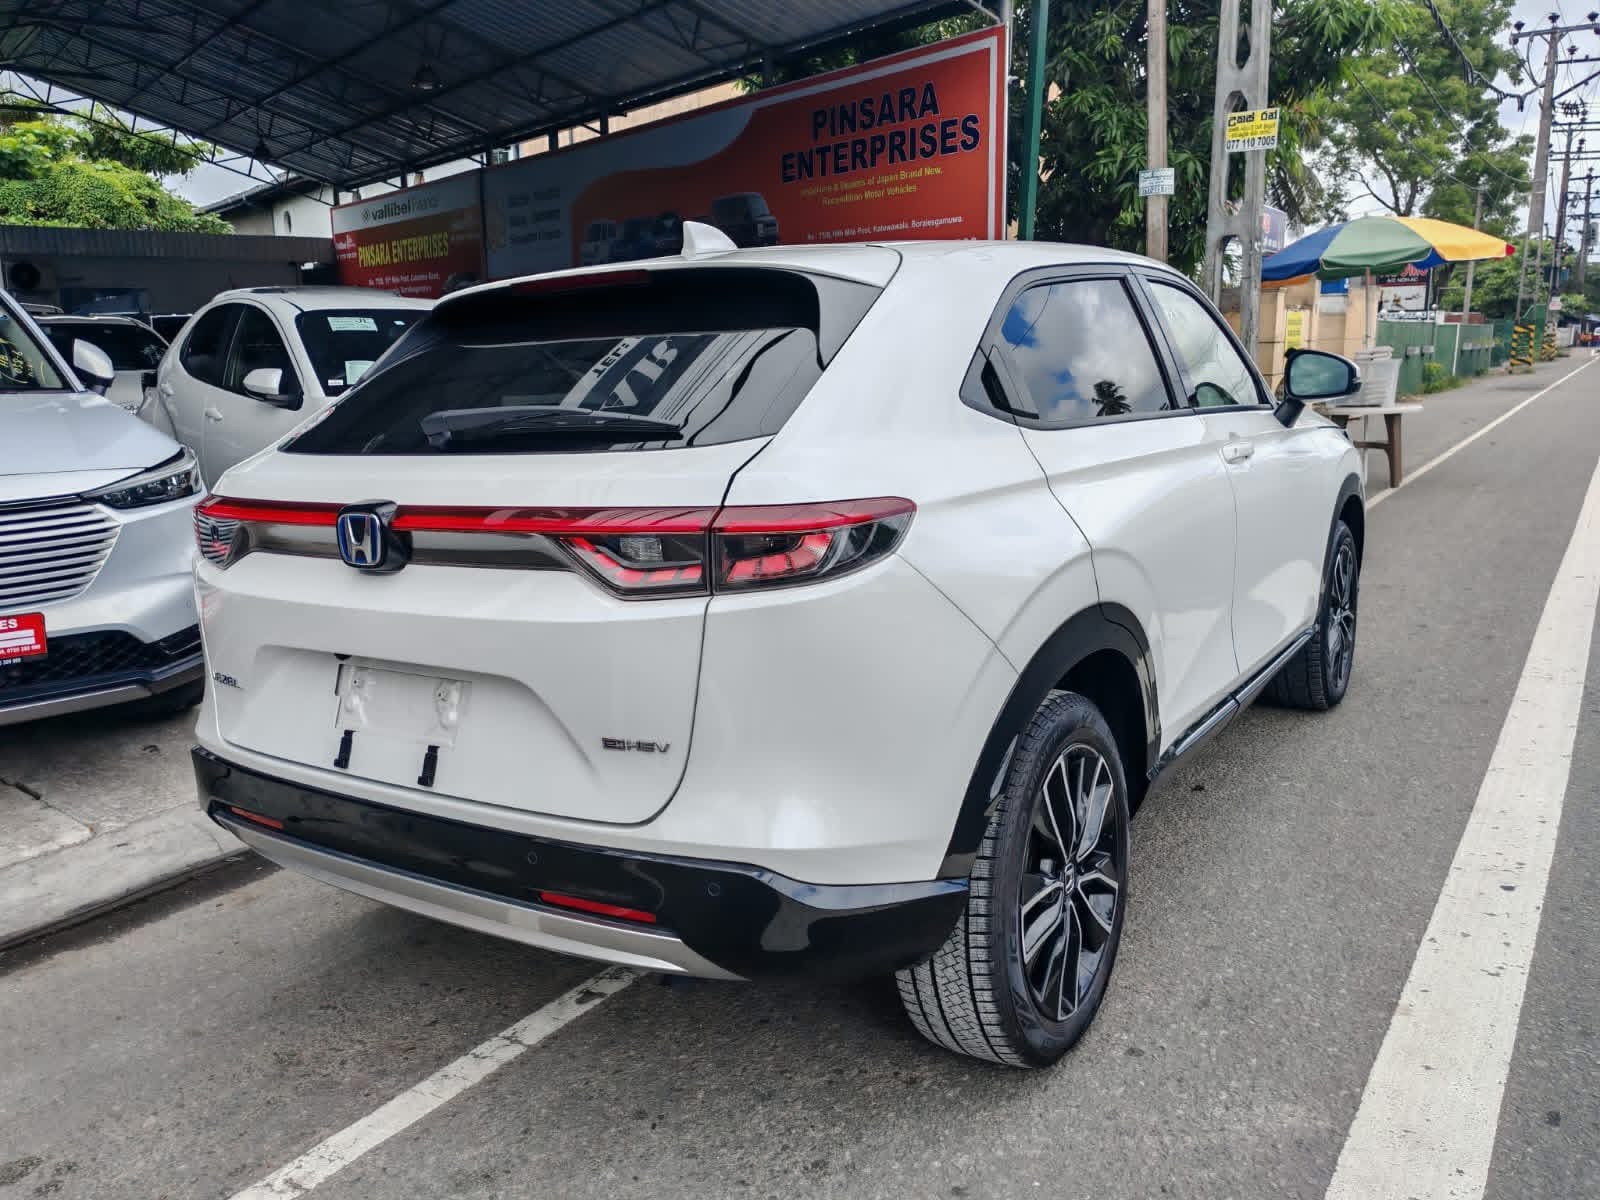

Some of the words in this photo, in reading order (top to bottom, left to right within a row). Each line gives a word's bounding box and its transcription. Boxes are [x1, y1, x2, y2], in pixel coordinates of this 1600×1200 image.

[811, 80, 940, 141] PINSARA
[781, 114, 980, 184] ENTERPRISES
[1227, 139, 1240, 150] 077
[900, 169, 923, 180] Brand
[864, 188, 884, 199] Motor
[358, 243, 391, 268] PINSARA
[392, 232, 449, 264] ENTERPRISES
